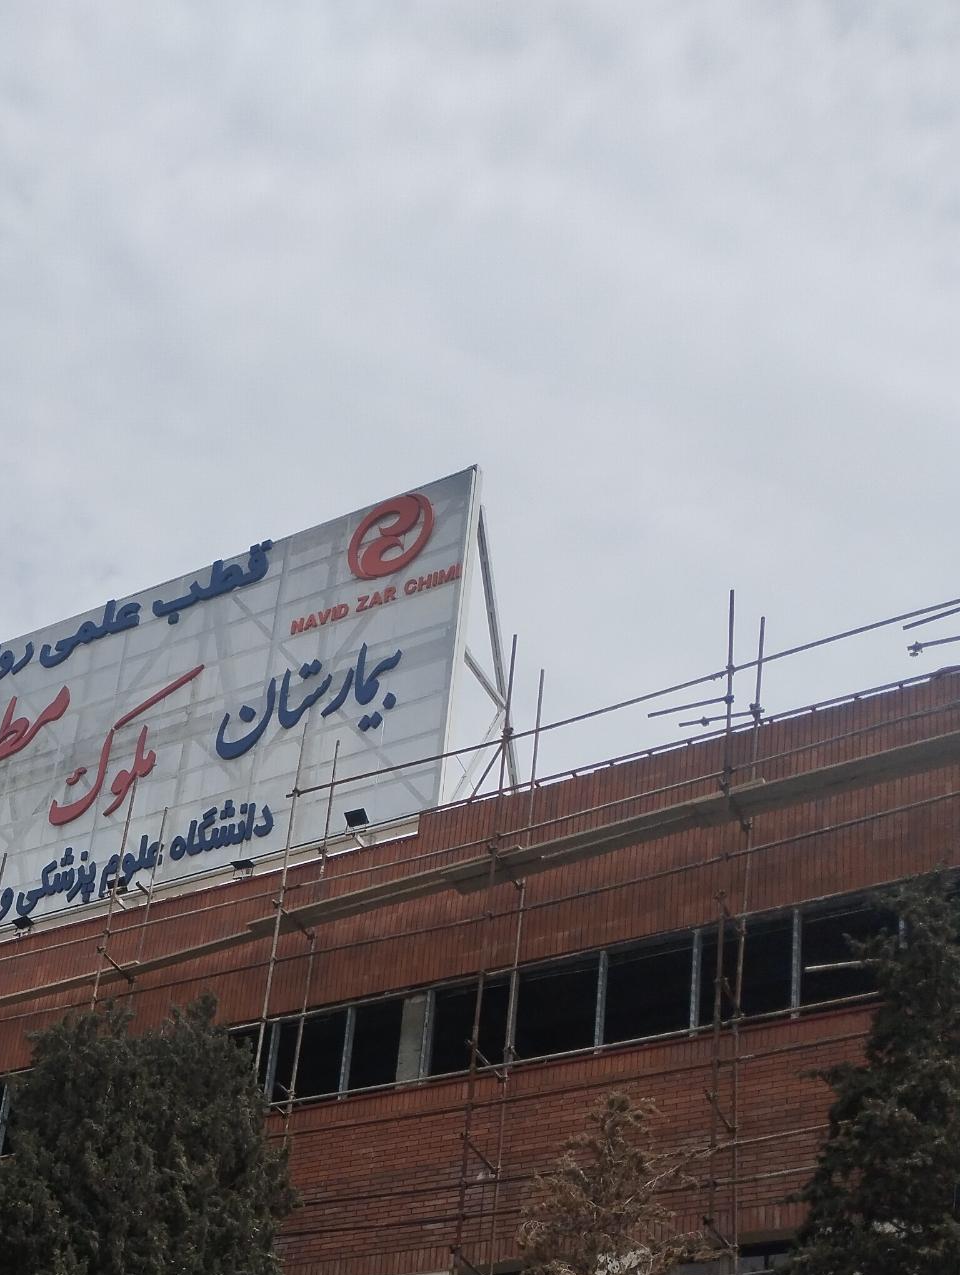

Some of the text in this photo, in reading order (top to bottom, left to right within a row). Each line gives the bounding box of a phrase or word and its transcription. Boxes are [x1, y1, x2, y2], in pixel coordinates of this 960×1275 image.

[152, 539, 272, 626] قطب
[290, 561, 463, 636] NAVID ZAR CHIMI
[39, 599, 141, 669] علمی
[215, 642, 403, 761] بیمارستان
[169, 799, 275, 862] دانشگاه
[15, 846, 97, 916] پزشکی
[98, 834, 165, 898] علوم
